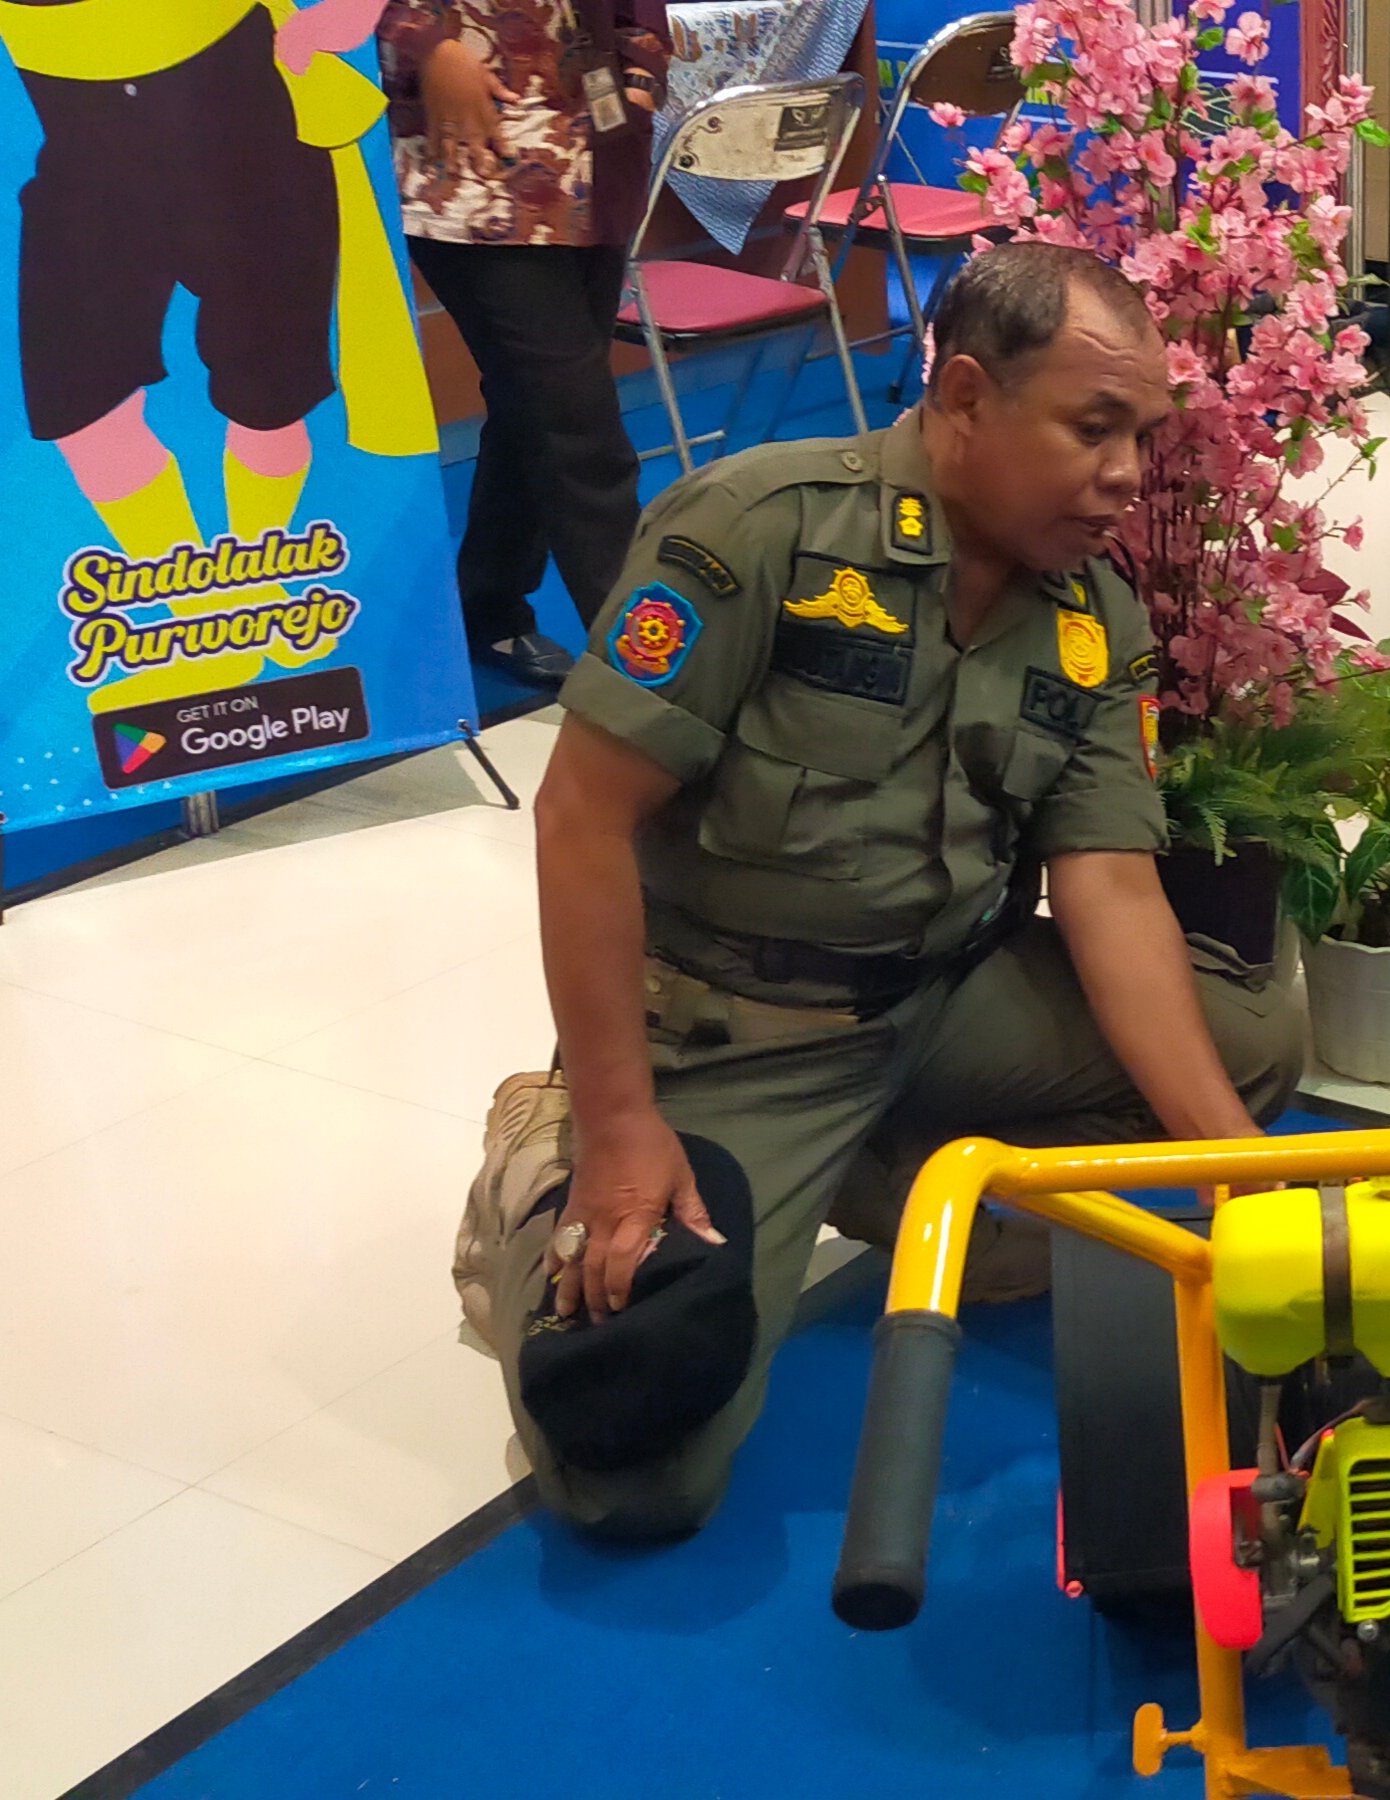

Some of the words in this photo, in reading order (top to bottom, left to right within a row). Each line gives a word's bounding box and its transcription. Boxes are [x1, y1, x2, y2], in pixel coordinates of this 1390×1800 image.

[65, 525, 343, 615] Sindolalak
[74, 590, 352, 680] Purworejo
[176, 705, 210, 723] GET
[213, 701, 229, 717] IT
[231, 696, 260, 712] ON
[181, 715, 289, 754] Google
[291, 705, 350, 734] Play
